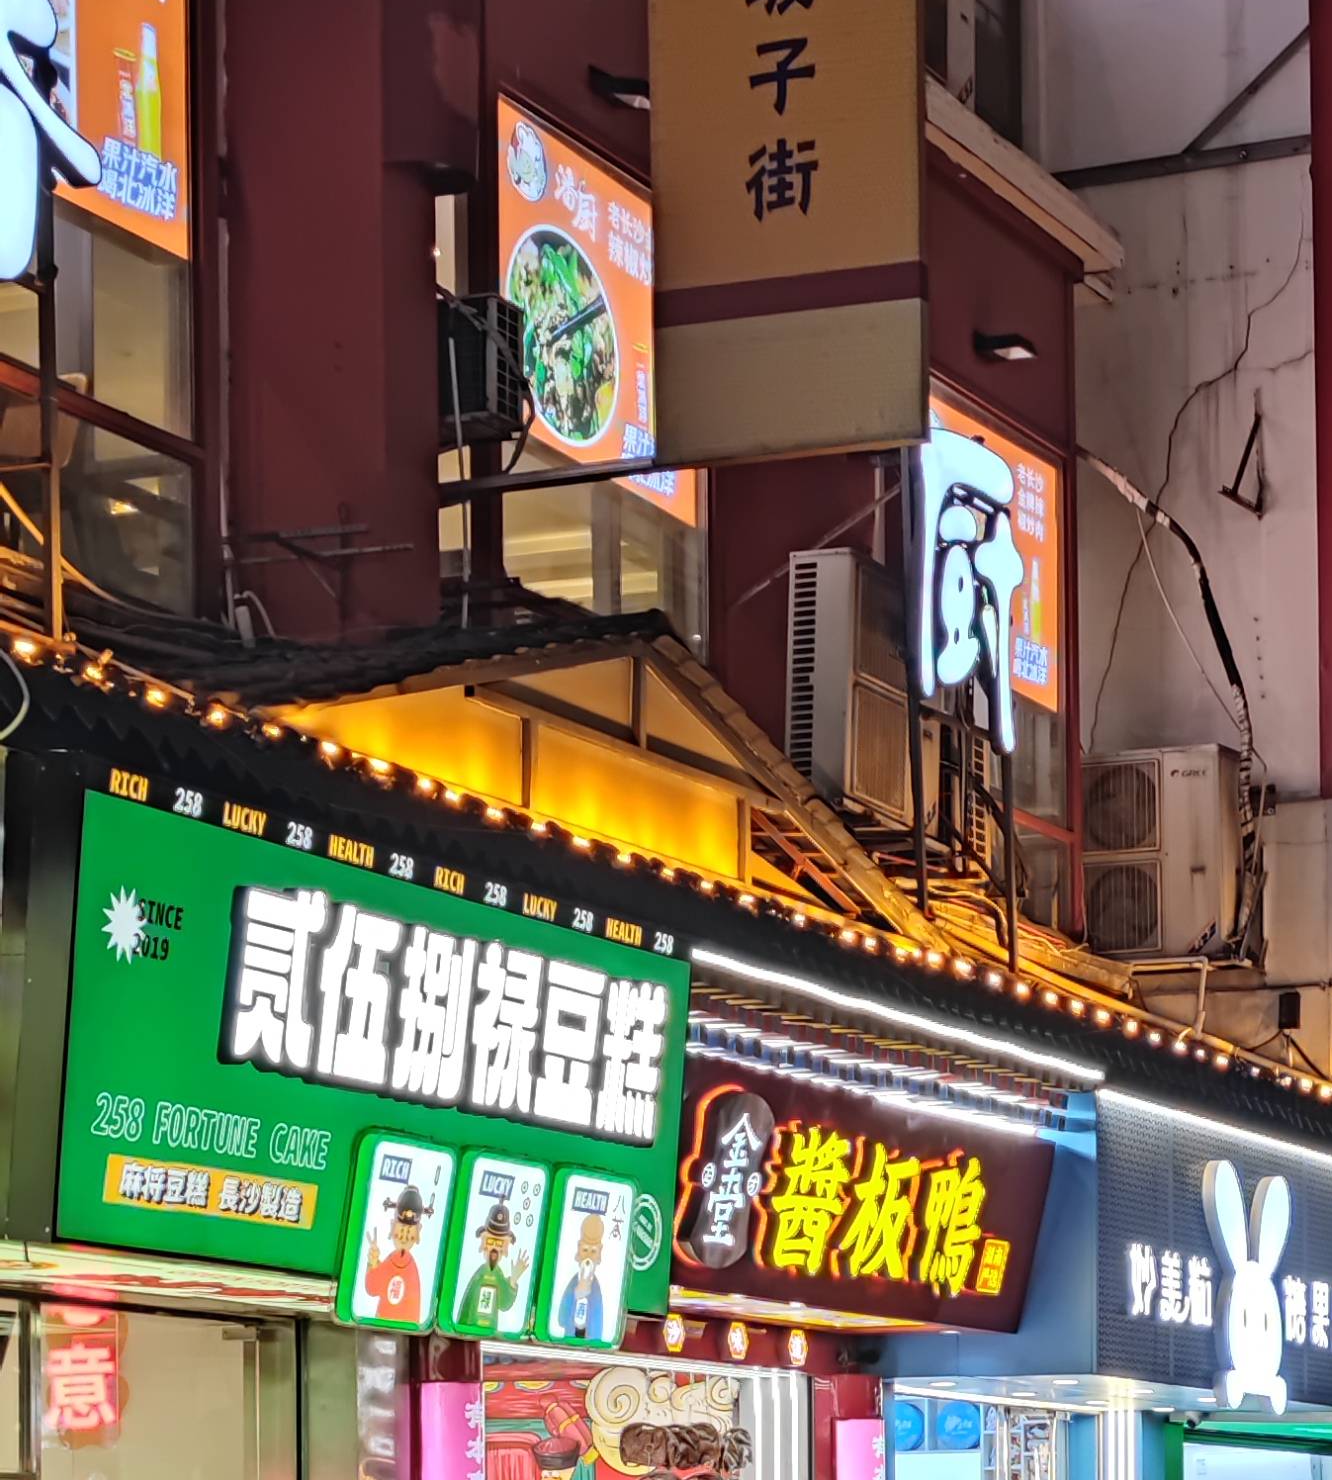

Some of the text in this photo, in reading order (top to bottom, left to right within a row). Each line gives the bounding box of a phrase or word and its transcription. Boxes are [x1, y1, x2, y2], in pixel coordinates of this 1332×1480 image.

[100, 137, 178, 192] 果汁汽水
[109, 768, 674, 956] RICH 258 LUCKY 258 HEALTH 258 RICH 258 LUCKY 258 HEALTH 258
[137, 897, 184, 931] SINCE
[132, 933, 170, 961] 2019
[230, 888, 668, 1142] 贰伍捌禄豆糕
[90, 1092, 331, 1170] 258 FORTUNE CAKE
[382, 1157, 410, 1180] RICH
[483, 1175, 513, 1195] LUCKY
[218, 1175, 302, 1223] 長沙製造
[576, 1192, 609, 1210] HEALTH
[772, 1126, 987, 1297] 醬板鴨
[46, 1346, 116, 1430] 意
